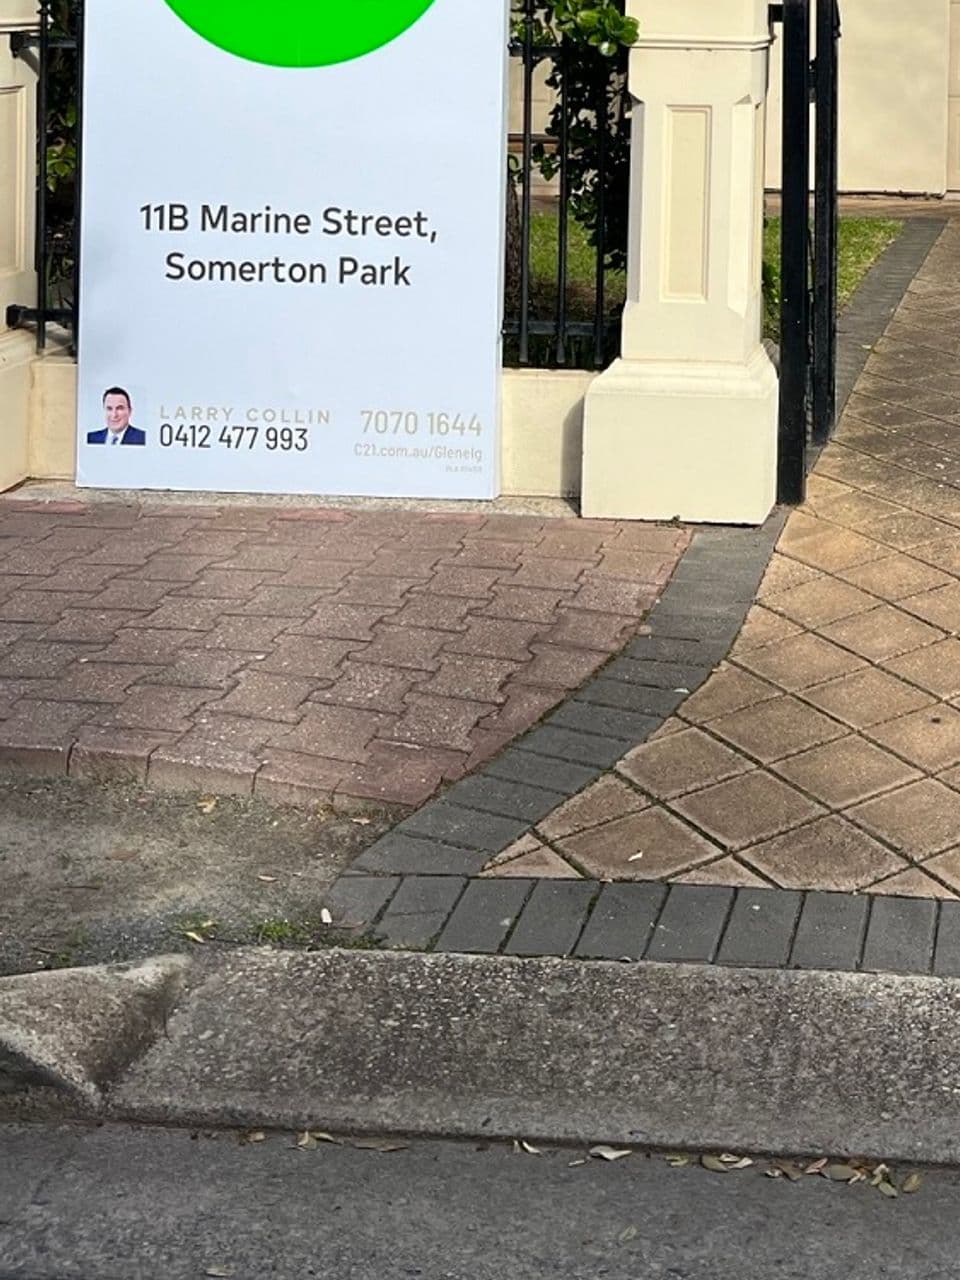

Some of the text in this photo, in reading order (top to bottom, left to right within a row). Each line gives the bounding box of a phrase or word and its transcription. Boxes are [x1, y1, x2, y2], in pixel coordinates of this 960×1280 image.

[140, 203, 437, 243] 11B Marine Street,
[165, 252, 411, 286] Somerton Park
[159, 405, 330, 424] LARRY COLLIN
[360, 409, 482, 437] 7070 1644
[159, 423, 309, 451] 0412 477 993
